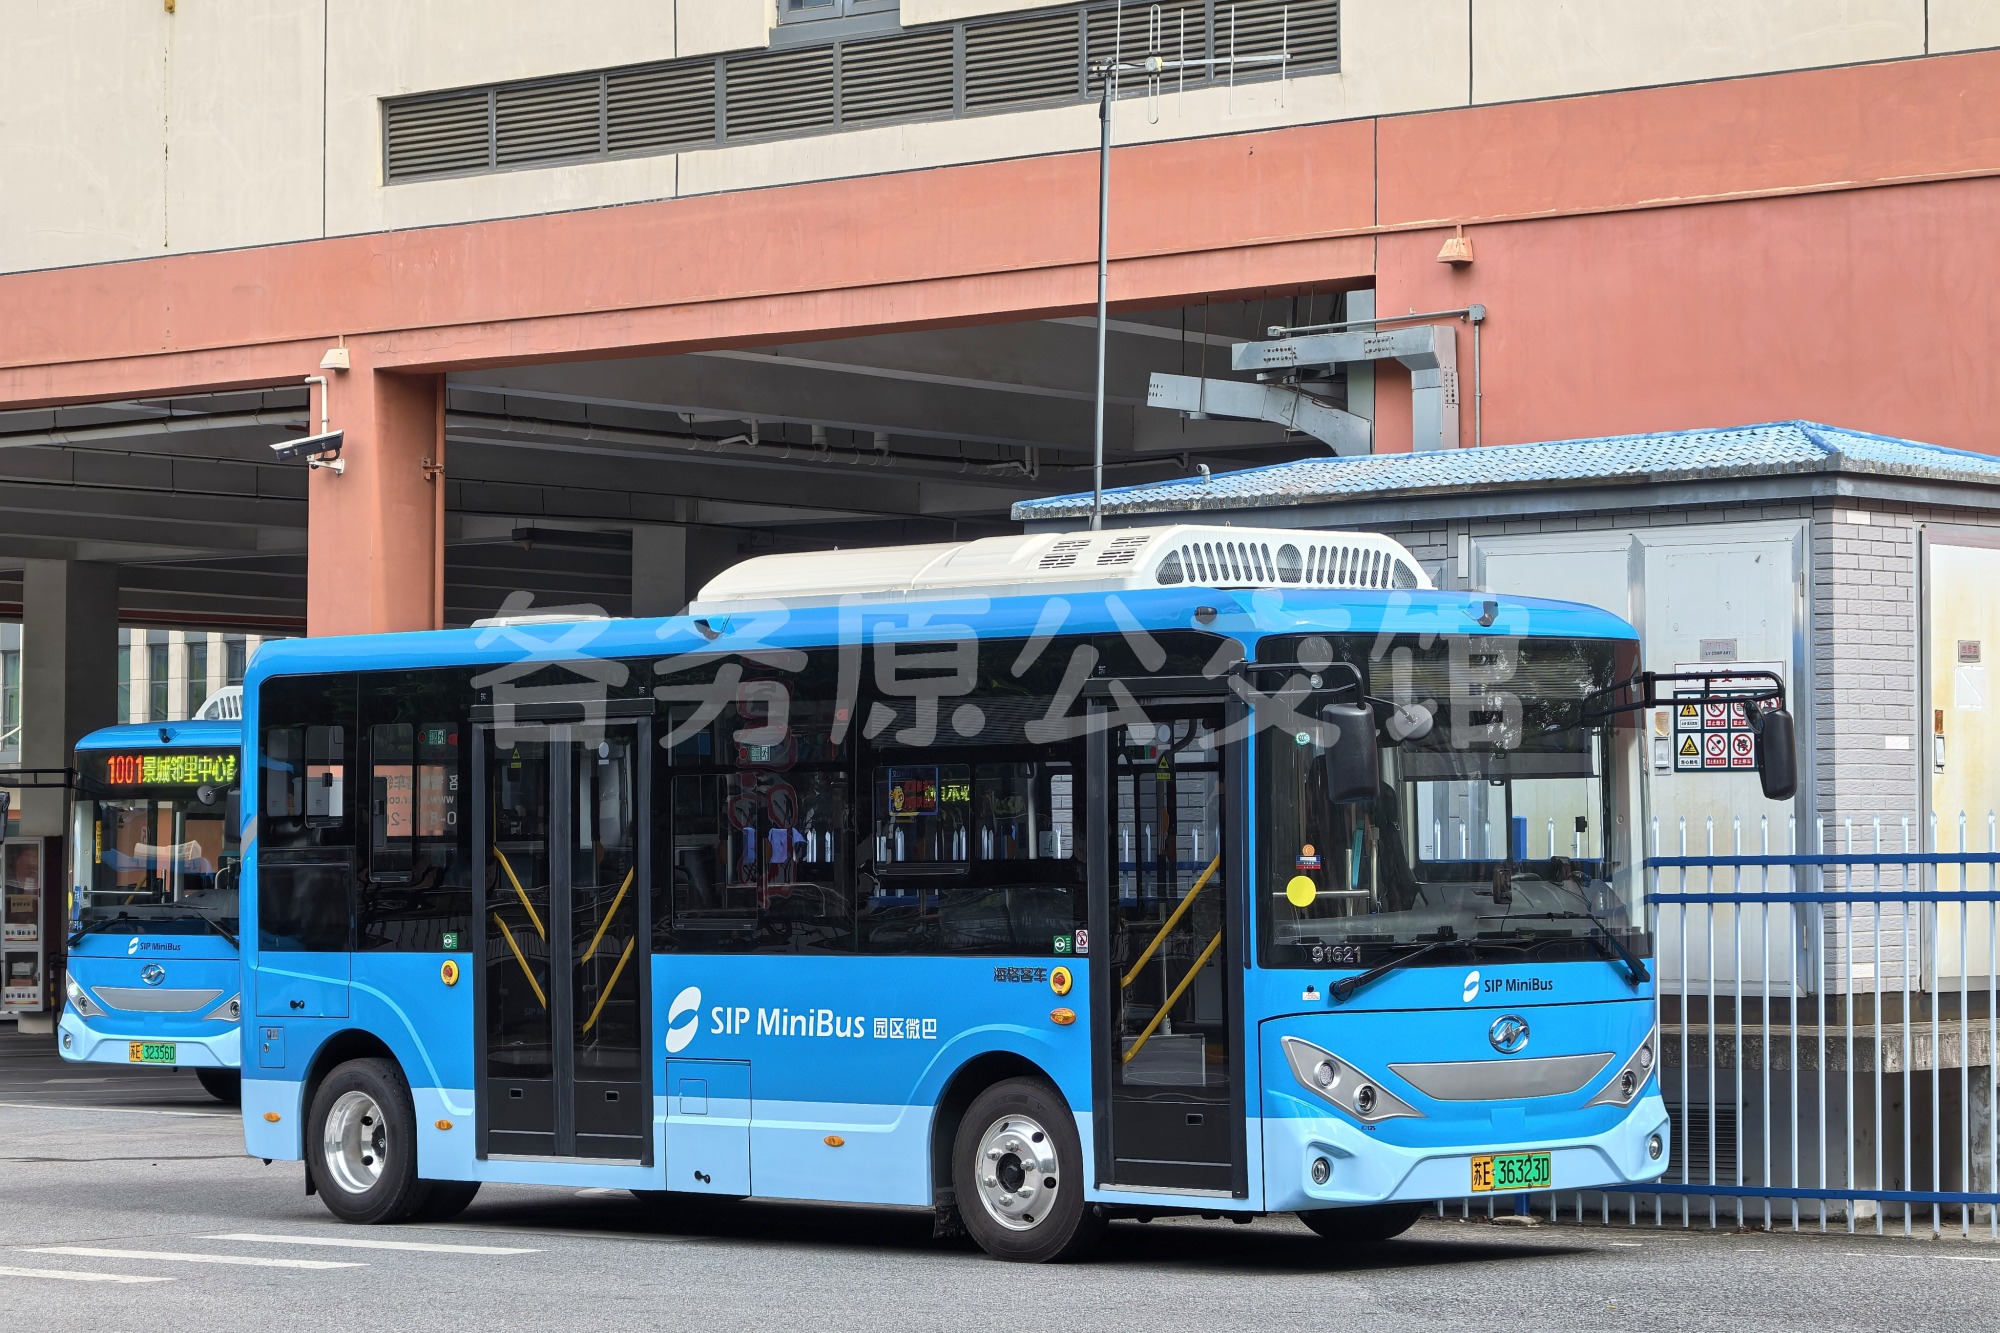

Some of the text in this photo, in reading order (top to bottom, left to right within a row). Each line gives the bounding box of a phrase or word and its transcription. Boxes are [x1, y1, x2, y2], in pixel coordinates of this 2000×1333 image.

[107, 754, 143, 784] 1001
[140, 942, 181, 951] SIP MiniBus
[1312, 945, 1361, 963] 91621
[1484, 978, 1553, 993] SIP MiniBus
[710, 1006, 937, 1040] SIP MiniBus 园区微巴
